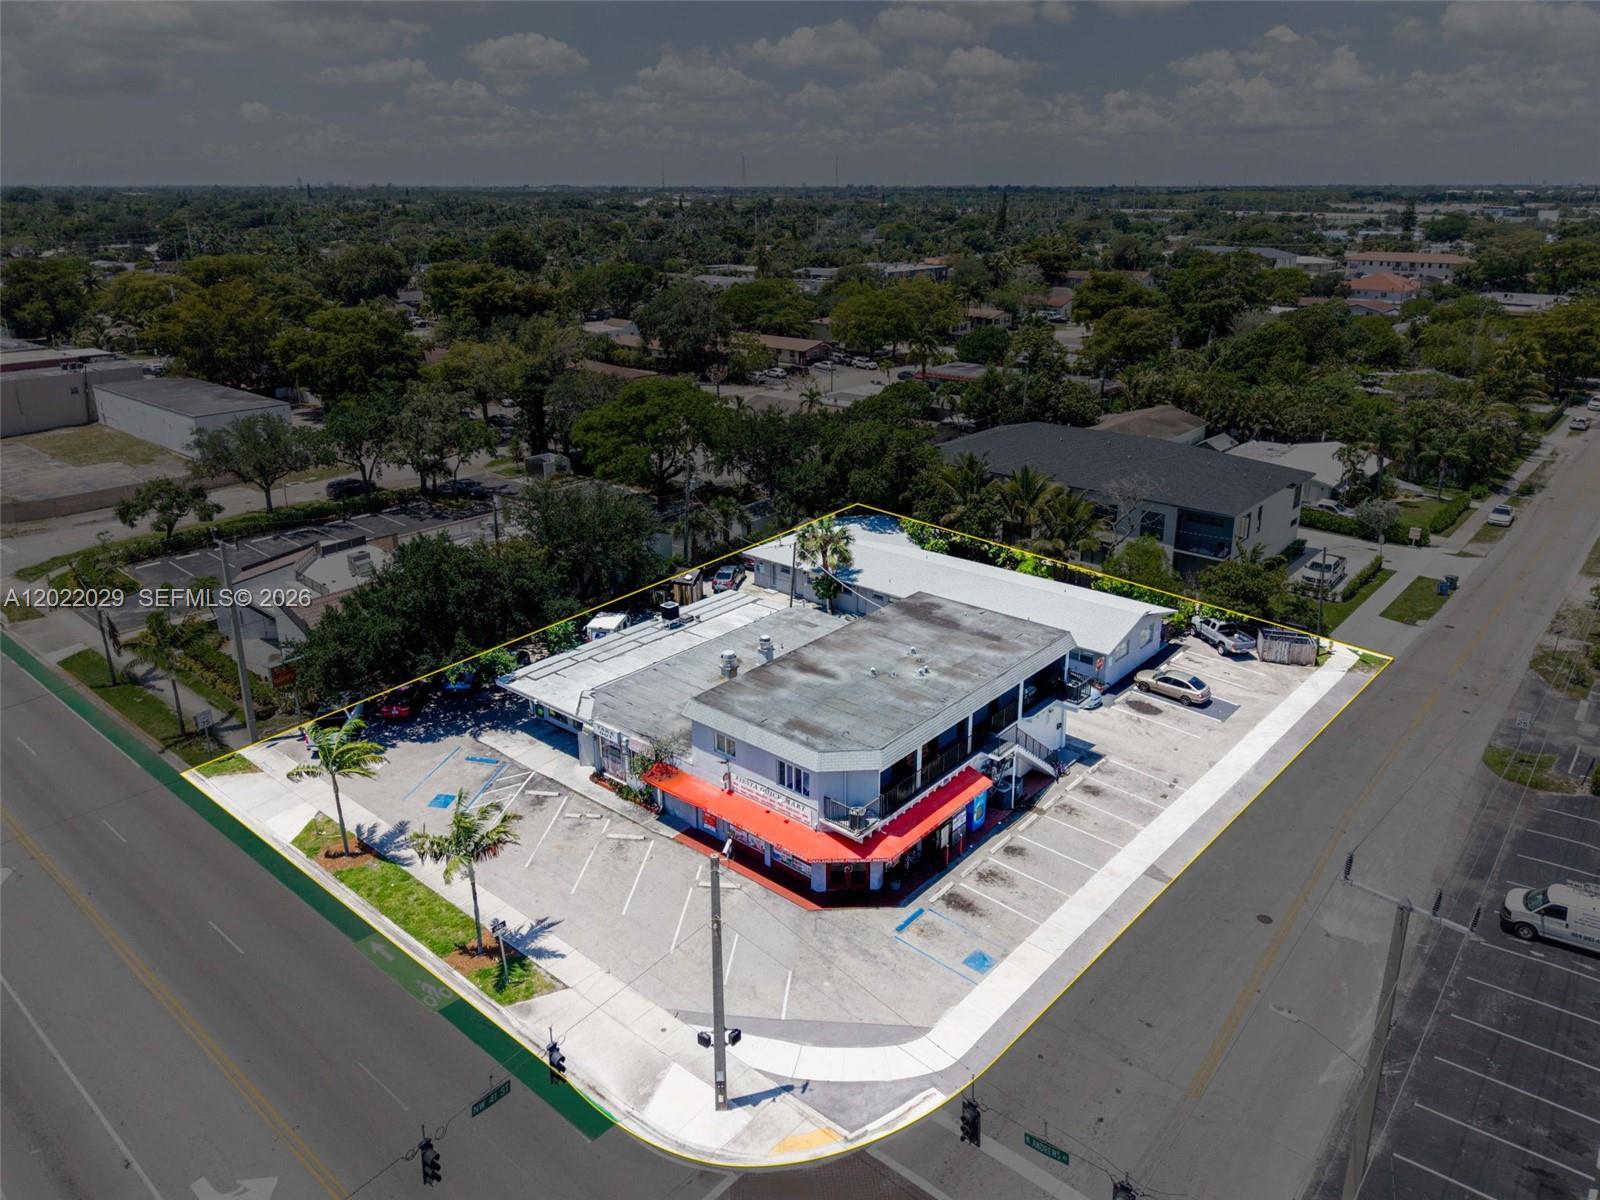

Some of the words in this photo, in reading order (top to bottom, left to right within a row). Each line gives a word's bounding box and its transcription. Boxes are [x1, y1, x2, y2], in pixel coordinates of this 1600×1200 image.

[735, 775, 758, 790] FIESTA
[785, 797, 806, 811] MART
[473, 1100, 485, 1115] NW
[488, 1092, 497, 1103] 41
[500, 1083, 509, 1096] ST
[1032, 1139, 1060, 1160] ANDREWS
